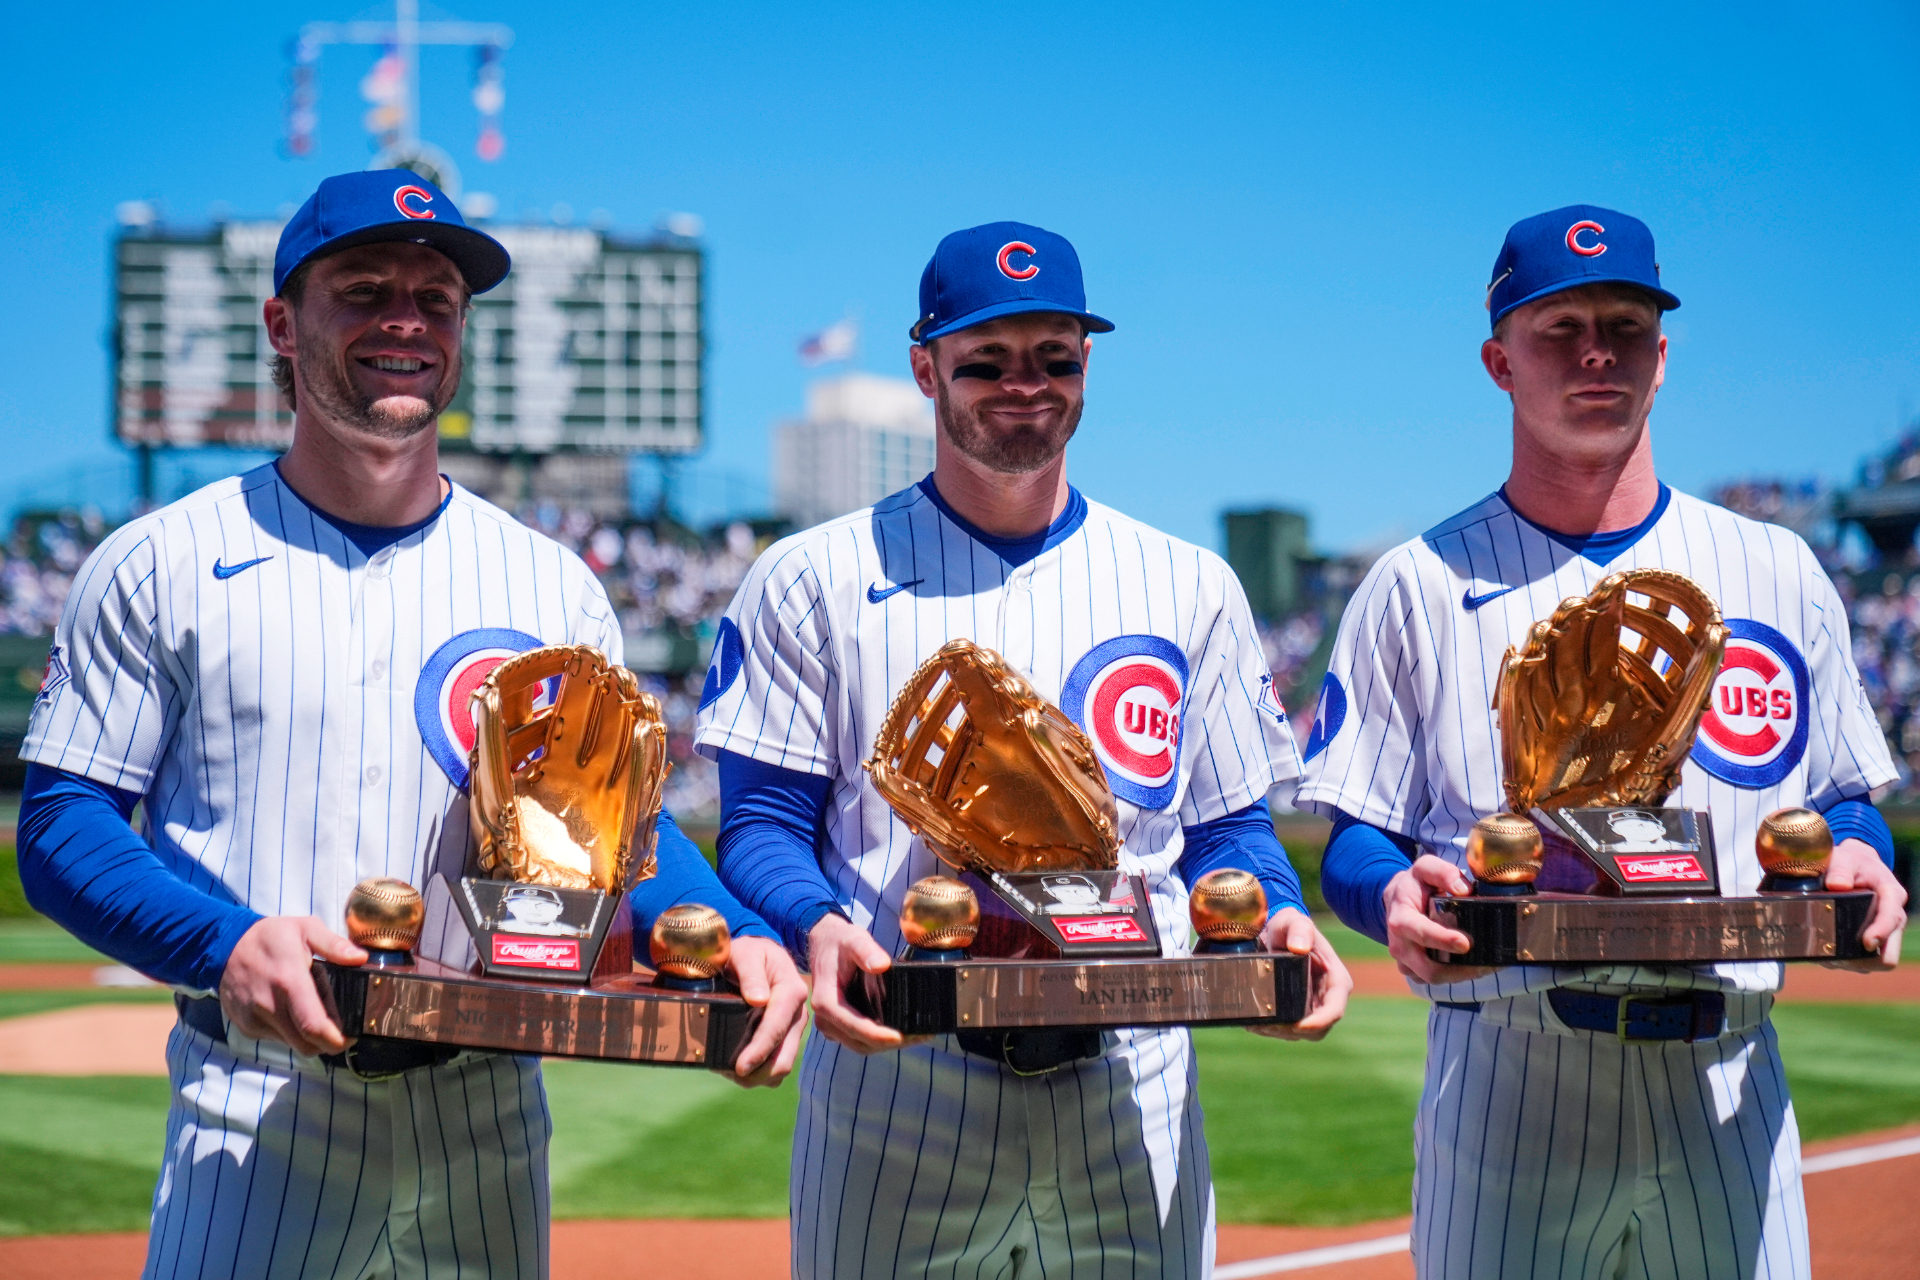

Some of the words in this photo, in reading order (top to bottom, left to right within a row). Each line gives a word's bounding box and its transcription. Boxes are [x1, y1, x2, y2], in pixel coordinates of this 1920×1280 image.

[394, 185, 435, 219] C
[1565, 220, 1607, 258] C
[996, 241, 1040, 281] C
[500, 944, 571, 960] Rawlings
[1080, 989, 1116, 1006] IAN
[1122, 987, 1174, 1004] HAPP
